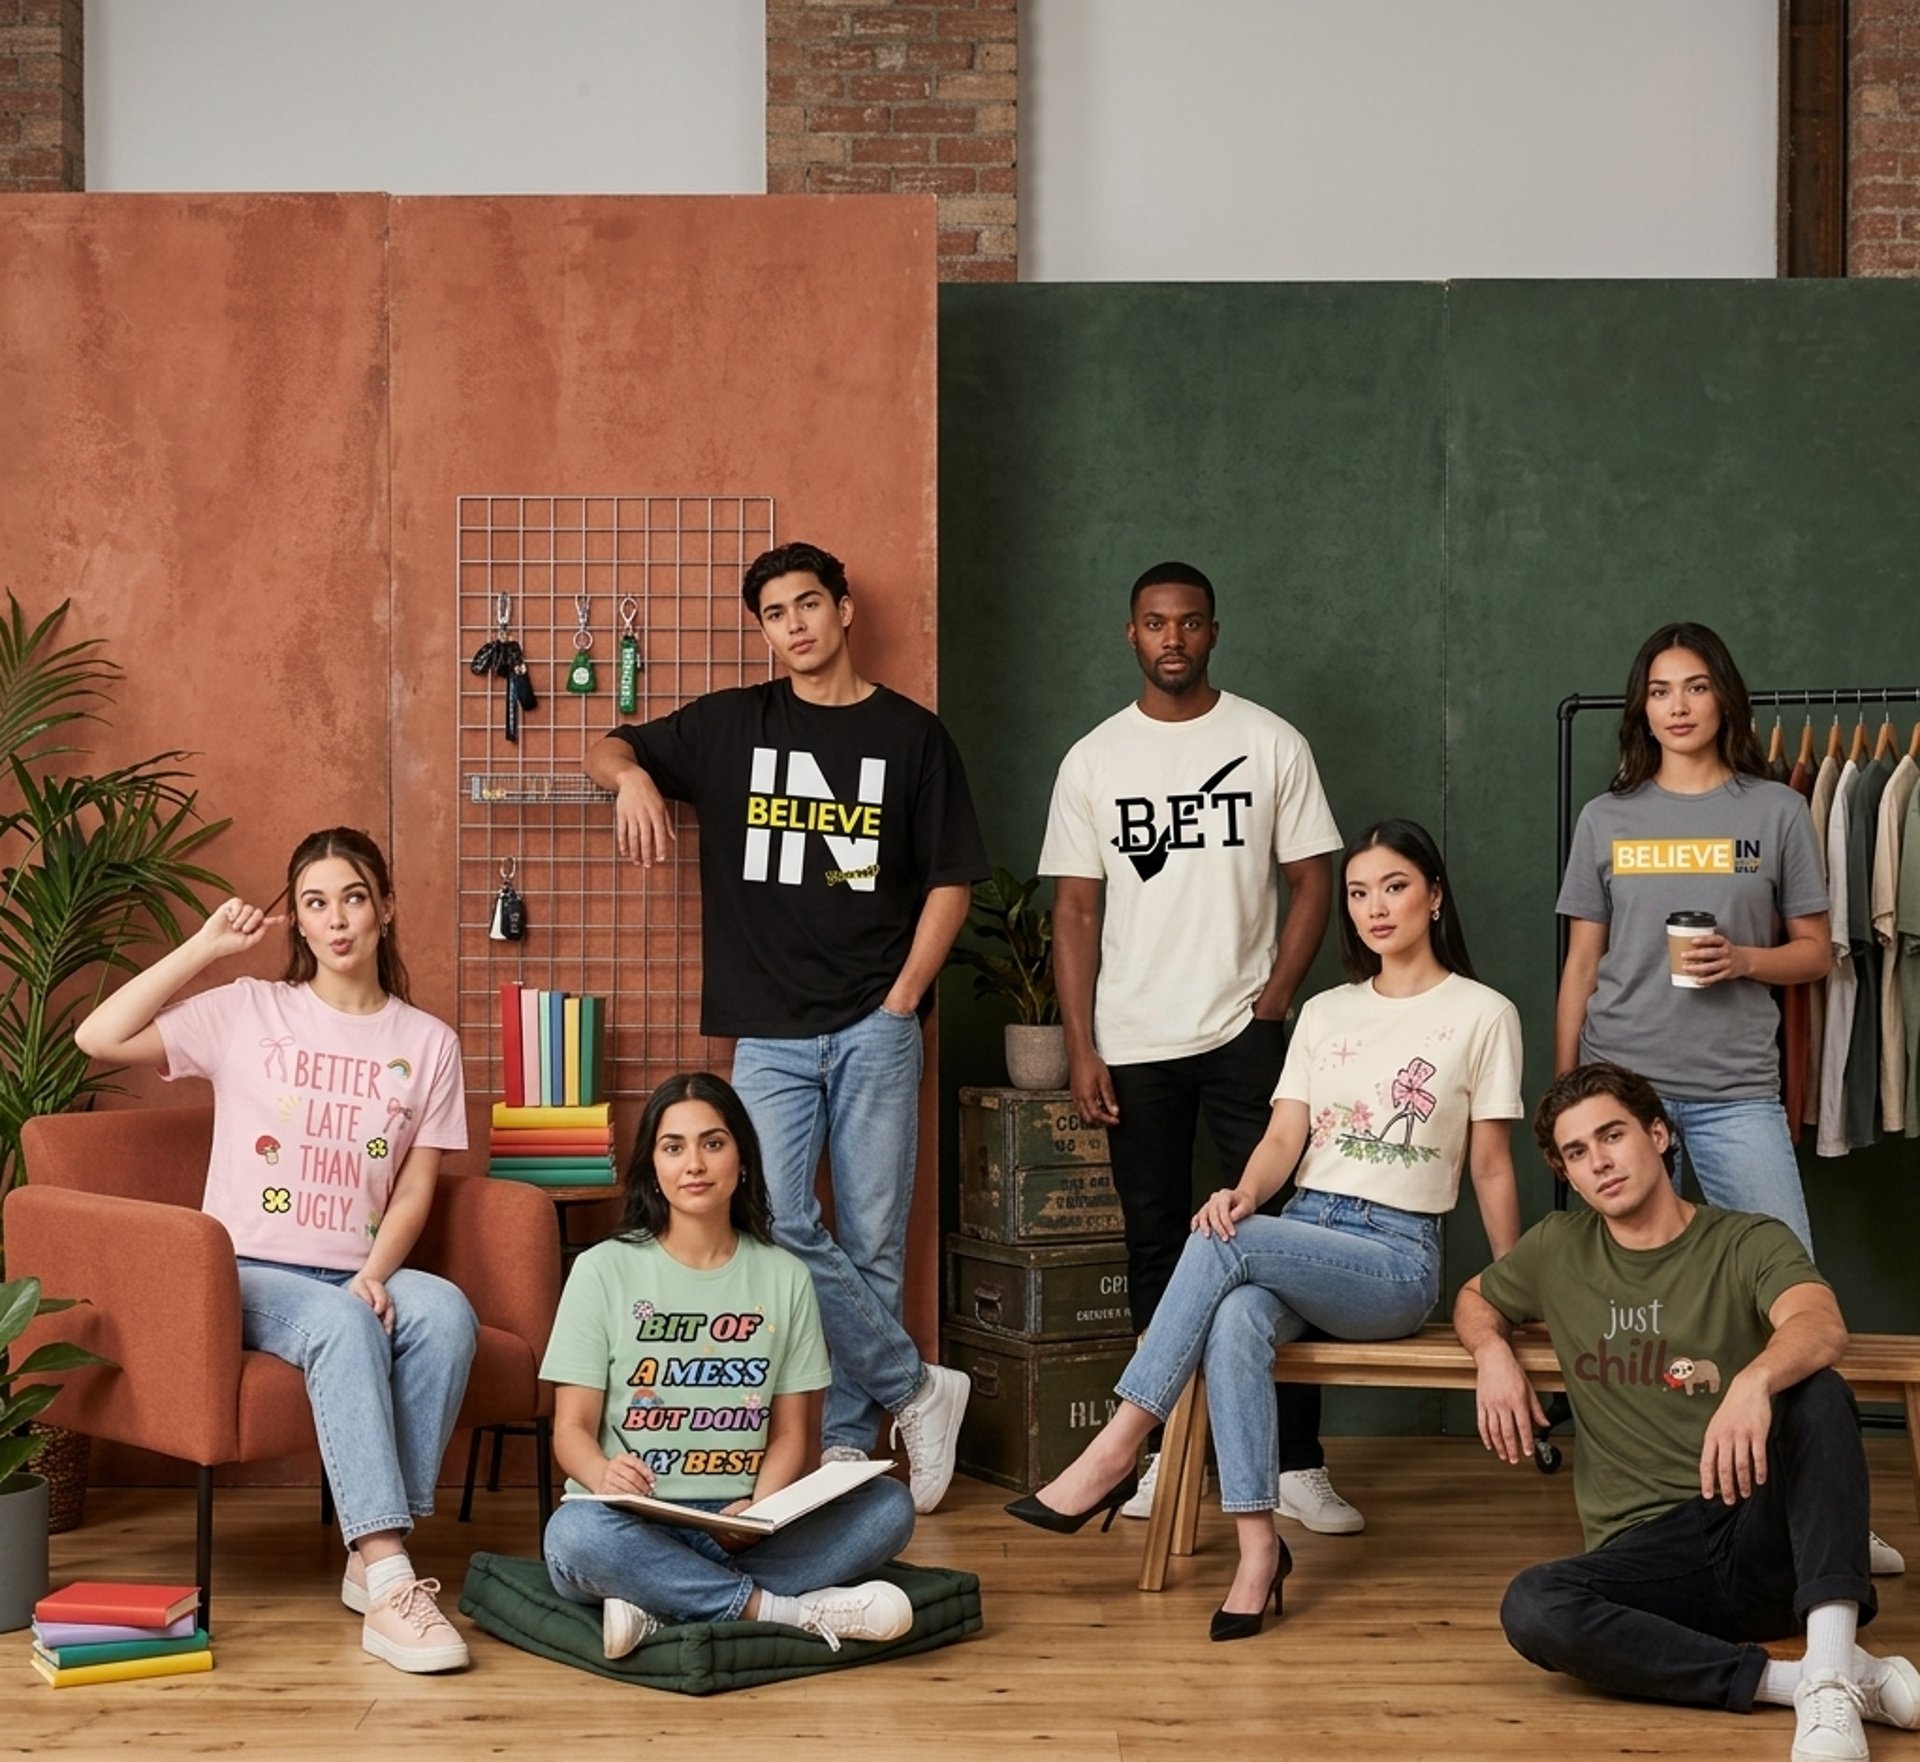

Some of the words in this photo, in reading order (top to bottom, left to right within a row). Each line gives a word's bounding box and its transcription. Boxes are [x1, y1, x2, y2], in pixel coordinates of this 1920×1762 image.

[747, 796, 883, 836] BELIEVE
[1115, 792, 1253, 853] BET
[1617, 844, 1729, 868] BELIEVE
[1735, 840, 1760, 858] IN
[294, 1050, 381, 1100] BETTER
[305, 1099, 363, 1142] LATE
[299, 1145, 363, 1189] THAN
[637, 1313, 707, 1341] BIT
[710, 1313, 763, 1341] OF
[1603, 1299, 1664, 1340] just
[628, 1357, 659, 1386] A
[662, 1357, 770, 1387] MESS
[1574, 1337, 1668, 1387] chill
[622, 1407, 690, 1432] BUT
[681, 1449, 765, 1476] BEST
